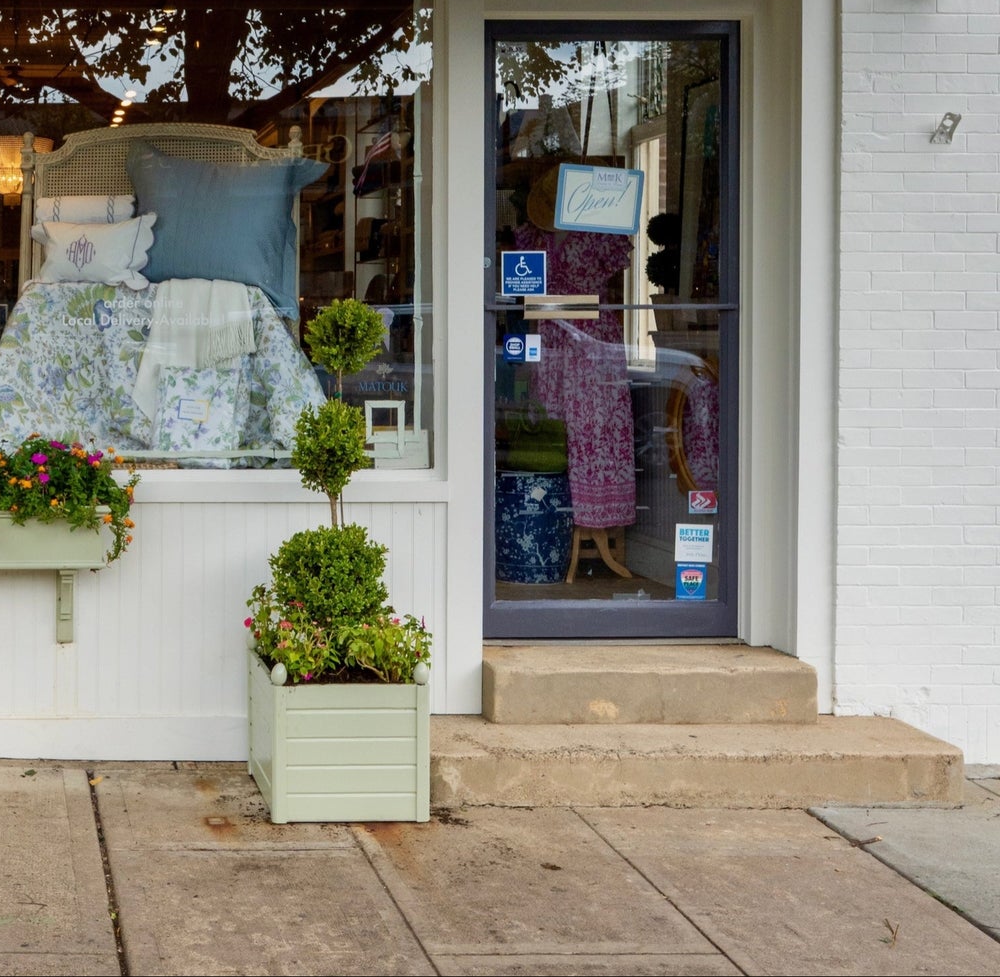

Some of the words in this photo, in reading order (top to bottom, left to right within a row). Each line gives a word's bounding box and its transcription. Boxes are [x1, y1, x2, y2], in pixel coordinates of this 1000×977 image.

[104, 297, 140, 308] order
[62, 314, 95, 326] Local
[100, 314, 154, 329] Delivery
[360, 381, 408, 392] MATOUK
[680, 528, 709, 536] BETTER
